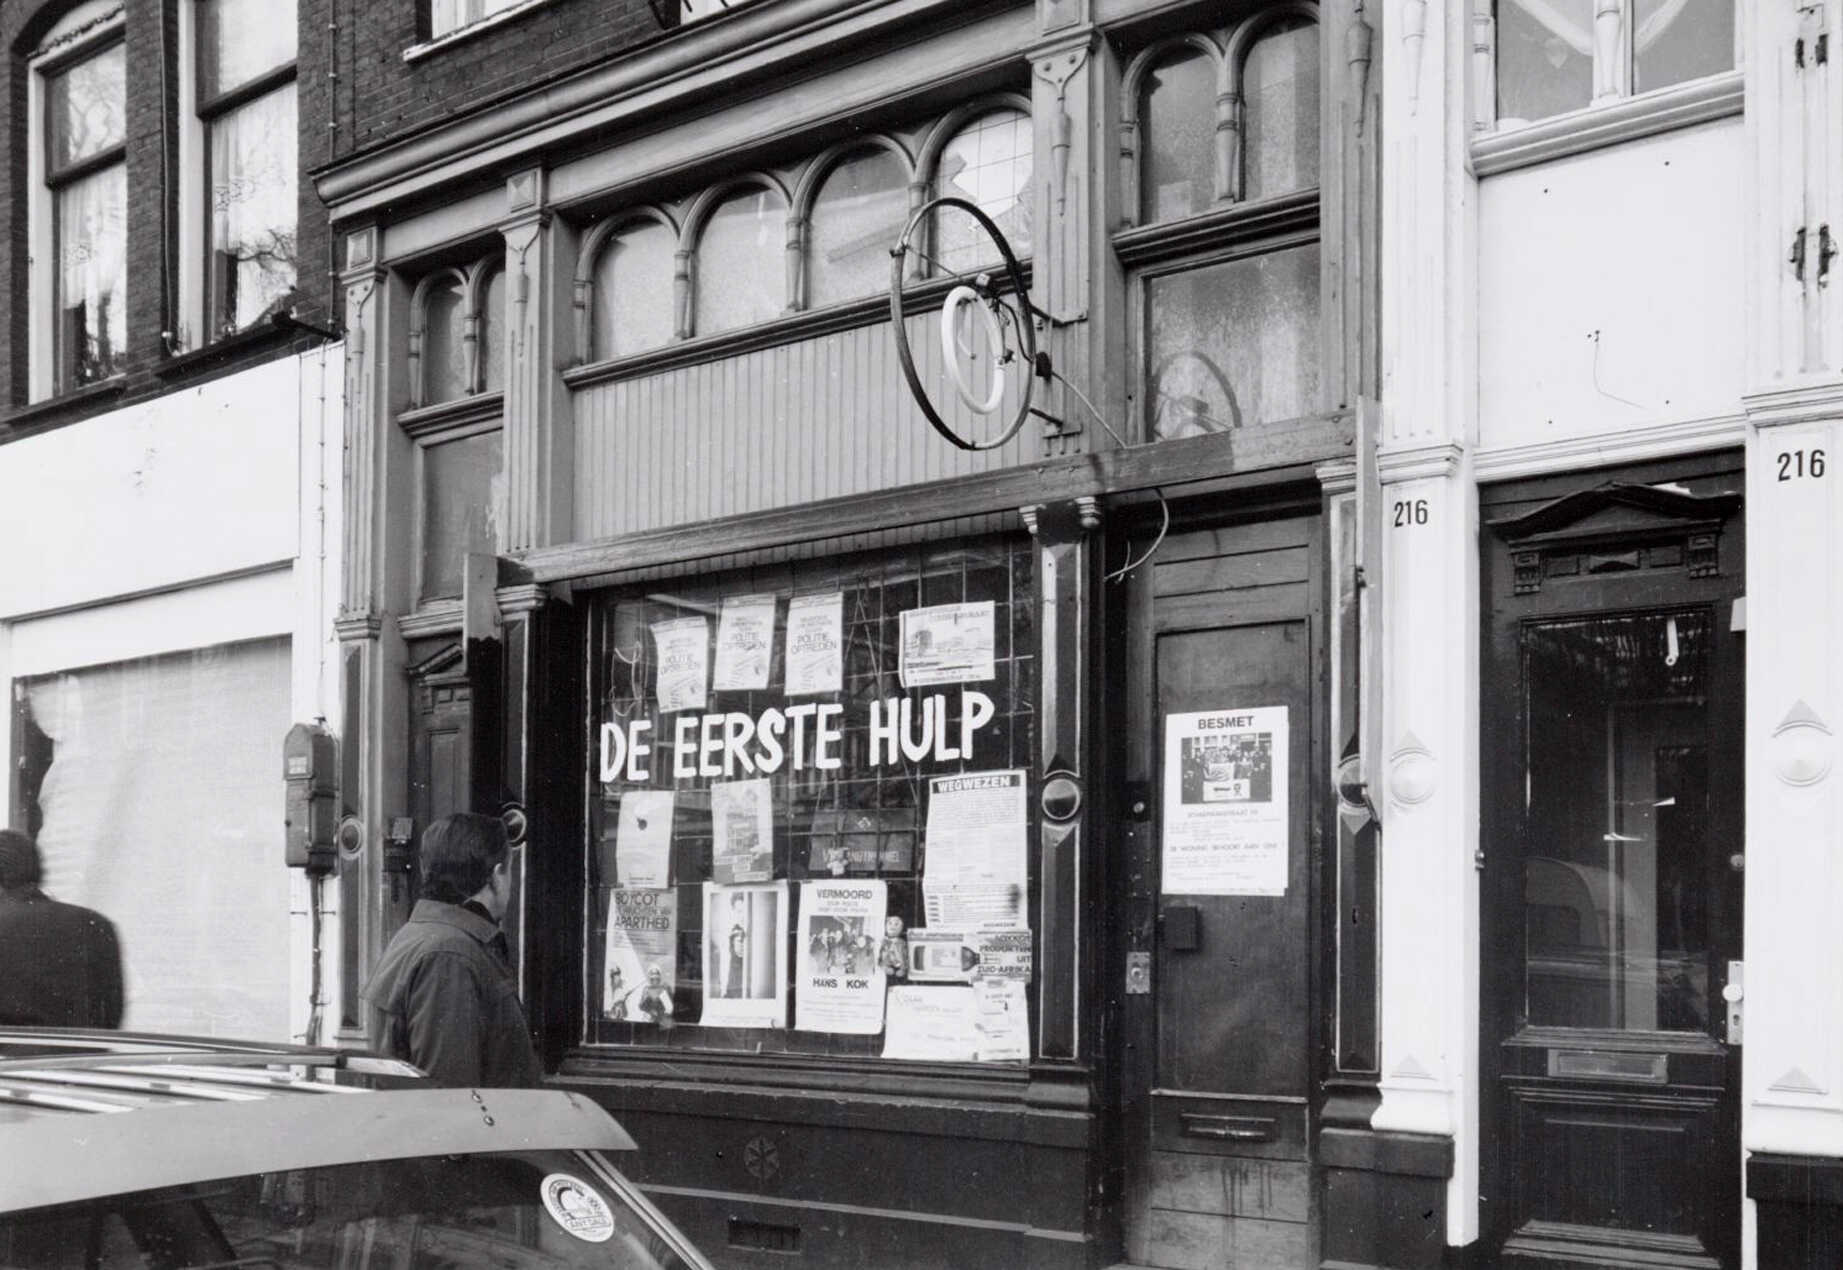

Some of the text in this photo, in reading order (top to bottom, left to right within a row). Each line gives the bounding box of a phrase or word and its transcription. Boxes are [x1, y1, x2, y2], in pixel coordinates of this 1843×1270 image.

[1776, 449, 1825, 482] 216
[1393, 499, 1429, 527] 216
[1198, 715, 1254, 730] BESMET
[599, 690, 996, 783] DE EERSTE HULP
[937, 775, 1011, 793] WEGWEZEN
[816, 888, 873, 900] VERMOORD
[812, 978, 870, 989] HANS KOK
